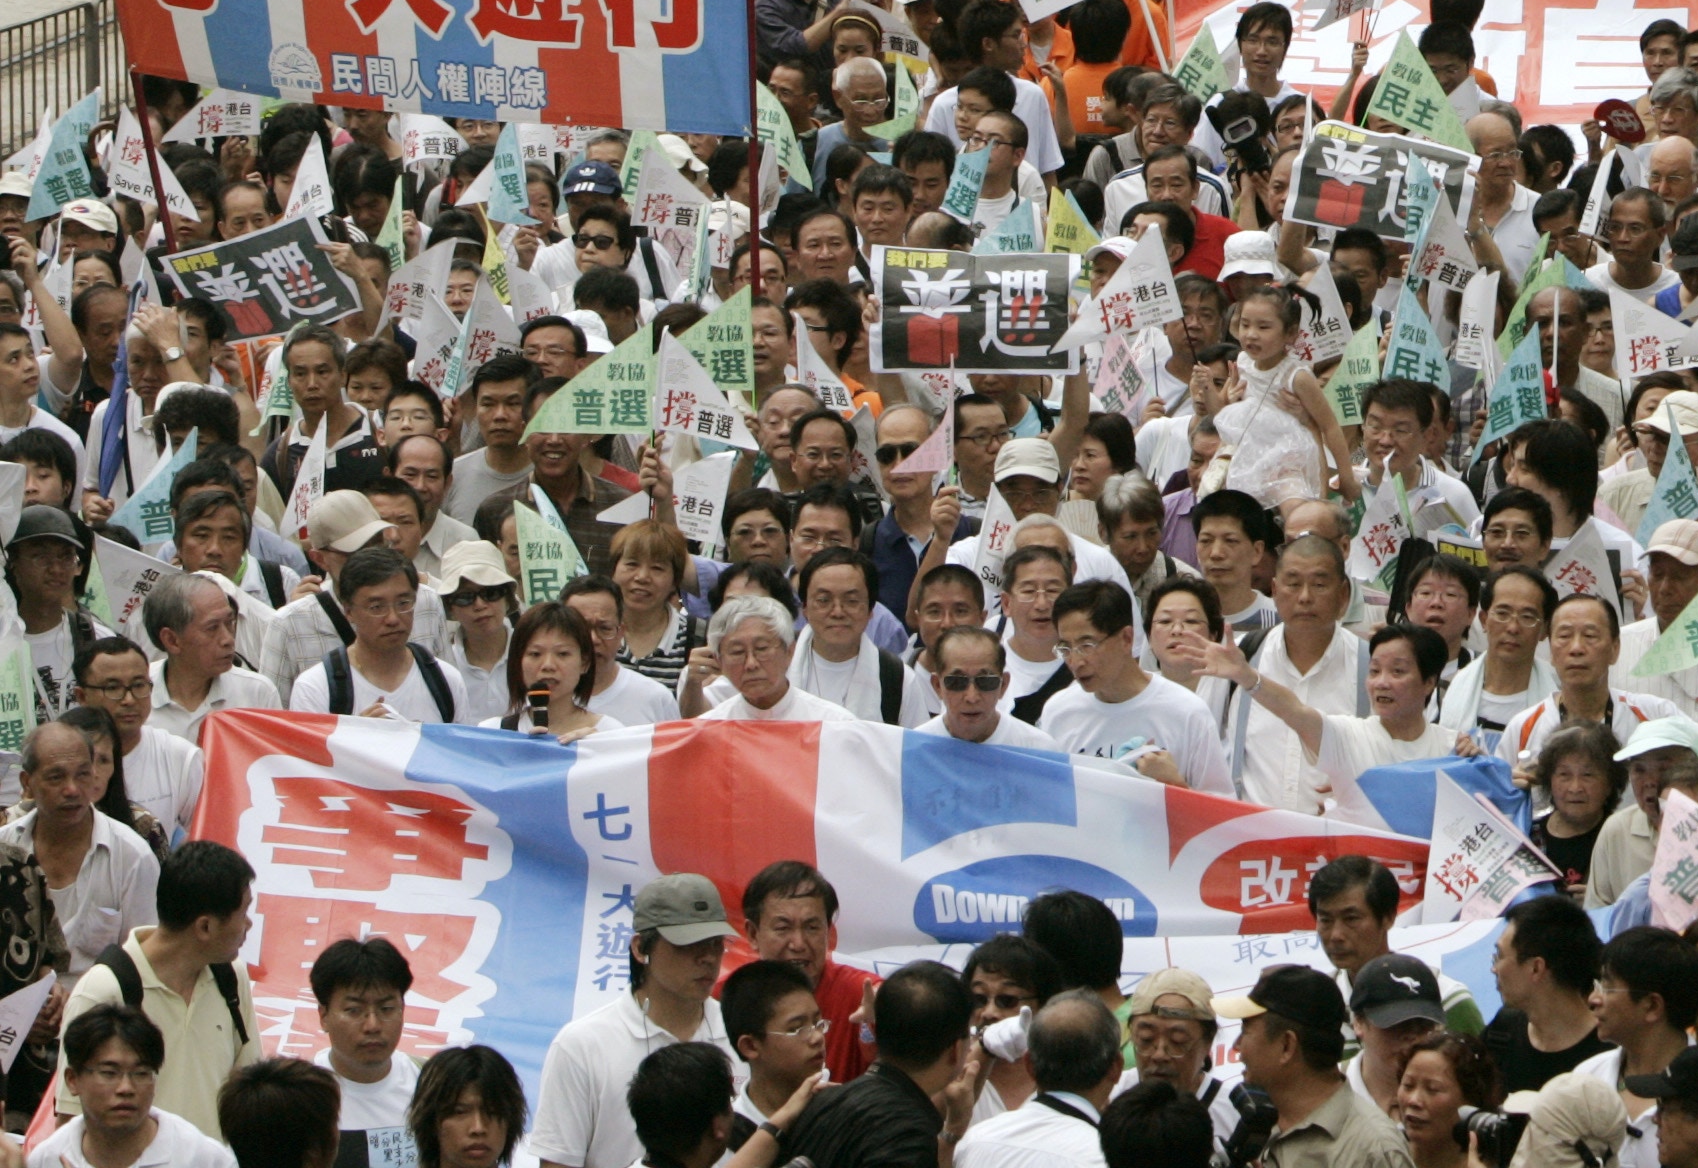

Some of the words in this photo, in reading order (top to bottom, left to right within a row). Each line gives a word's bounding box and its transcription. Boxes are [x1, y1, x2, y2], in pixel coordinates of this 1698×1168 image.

[887, 36, 920, 58] 普選
[330, 53, 548, 109] 民間人權陣線
[1391, 59, 1424, 86] 教協
[197, 105, 224, 134] 撐
[225, 102, 252, 117] 港台
[1374, 80, 1437, 132] 民主
[422, 136, 461, 158] 普選
[523, 142, 549, 159] 港台
[114, 173, 143, 193] Save
[640, 192, 674, 224] 撐
[886, 249, 949, 268] 我們要
[1099, 291, 1137, 335] 撐
[1132, 281, 1168, 303] 港台
[706, 324, 745, 344] 教協
[1628, 335, 1662, 373] 撐
[607, 361, 647, 382] 教協
[1510, 363, 1538, 382] 教協
[572, 388, 648, 428] 普選
[661, 389, 698, 430] 撐
[697, 409, 734, 440] 普選
[1487, 386, 1542, 433] 普選
[681, 494, 715, 518] 港台
[525, 542, 564, 562] 教協
[1432, 856, 1479, 904] 撐
[1459, 822, 1495, 857] 港台
[583, 790, 639, 992] 七一大遊行
[932, 885, 1024, 925] Down
